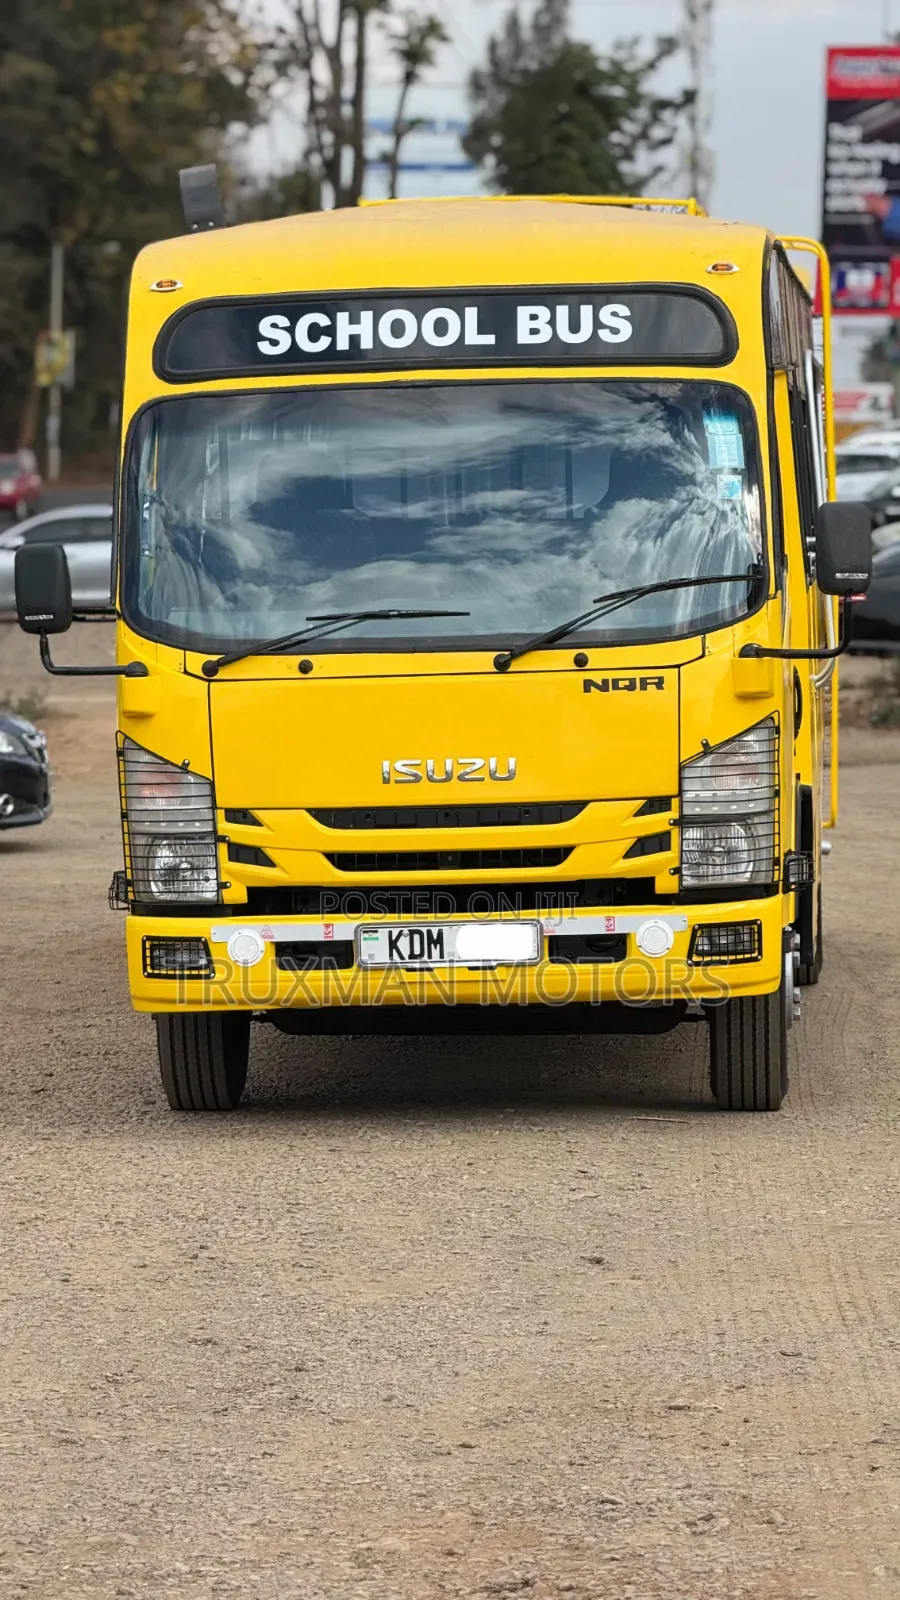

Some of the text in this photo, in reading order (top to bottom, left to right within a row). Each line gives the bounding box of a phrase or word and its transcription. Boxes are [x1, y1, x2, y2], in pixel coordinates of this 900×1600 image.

[257, 304, 633, 355] SCHOOL BUS
[583, 676, 665, 693] NQR
[381, 757, 517, 785] ISUZU
[387, 928, 445, 961] KDM
